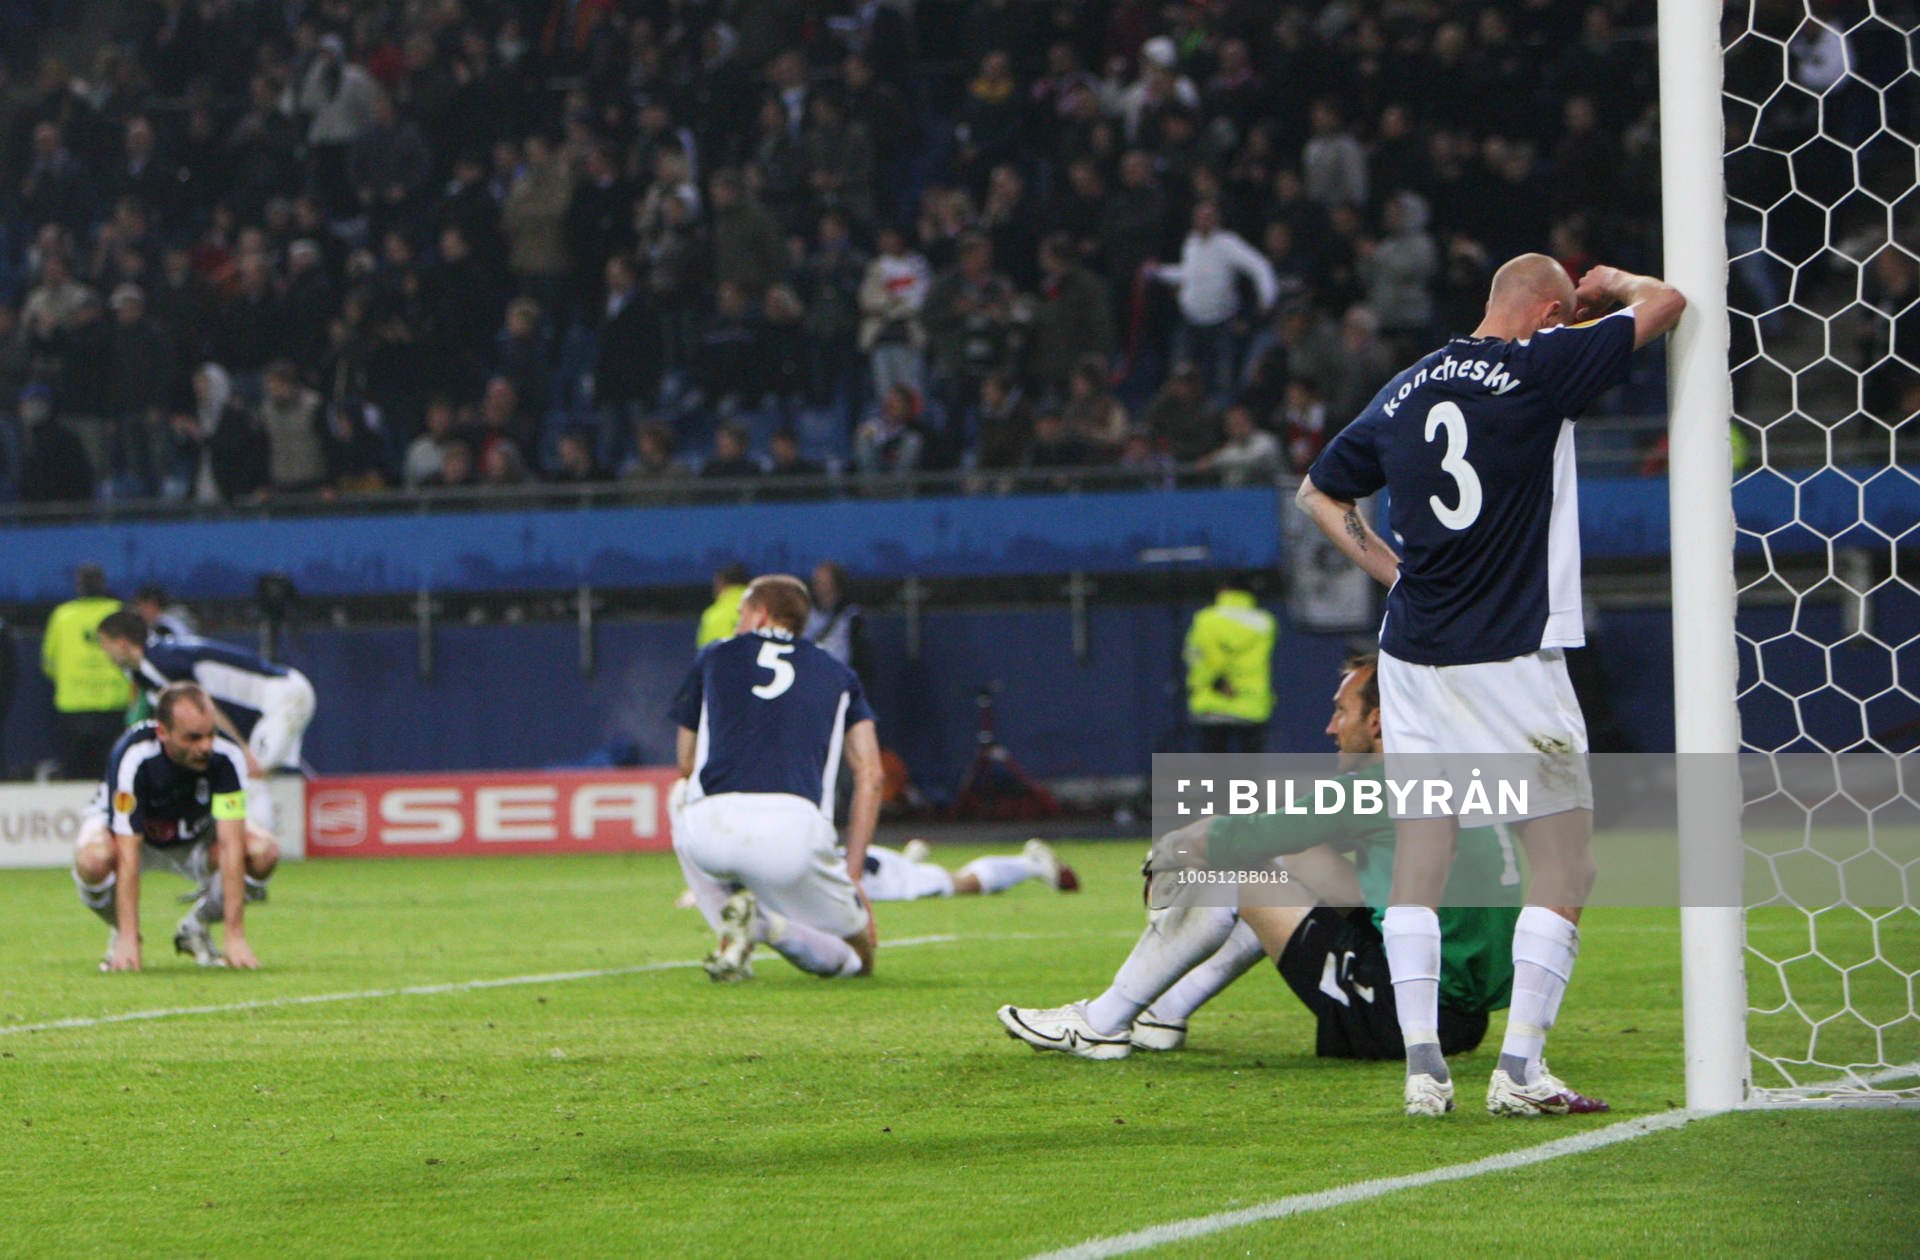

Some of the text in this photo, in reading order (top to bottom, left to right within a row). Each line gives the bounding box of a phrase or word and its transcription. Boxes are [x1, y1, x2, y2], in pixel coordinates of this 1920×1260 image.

[1424, 401, 1483, 531] 3
[751, 640, 796, 700] 5
[1, 808, 81, 844] URO
[379, 782, 658, 846] SEA
